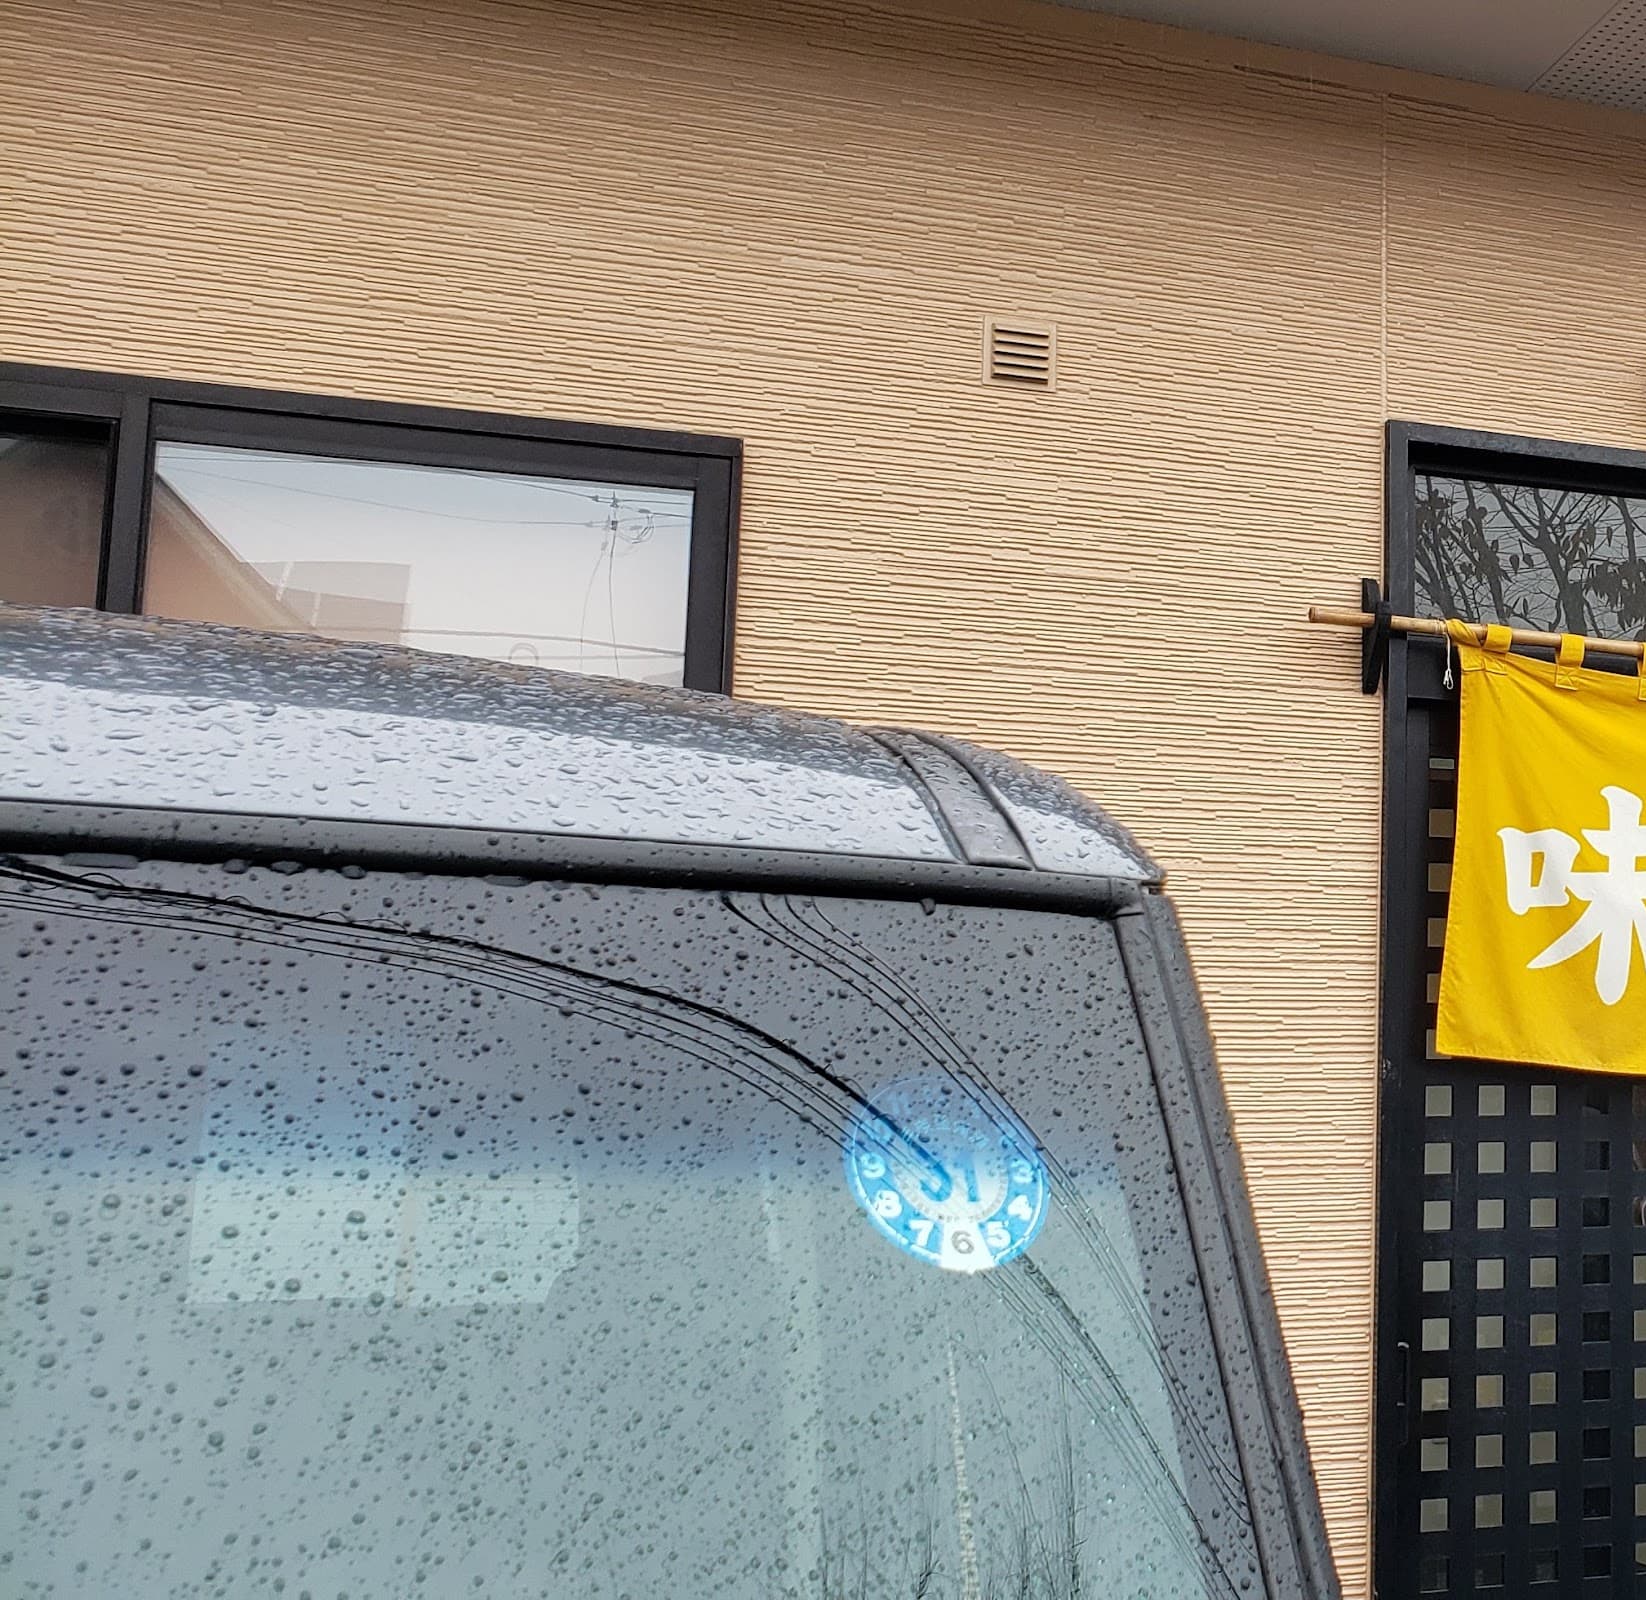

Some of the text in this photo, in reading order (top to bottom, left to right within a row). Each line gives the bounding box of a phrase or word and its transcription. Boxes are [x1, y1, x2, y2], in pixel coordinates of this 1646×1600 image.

[860, 1152, 886, 1179] 9
[875, 1189, 902, 1218] 8
[1007, 1194, 1033, 1221] 4
[909, 1218, 935, 1248] 7
[950, 1230, 974, 1255] 6
[985, 1220, 1011, 1249] 5
